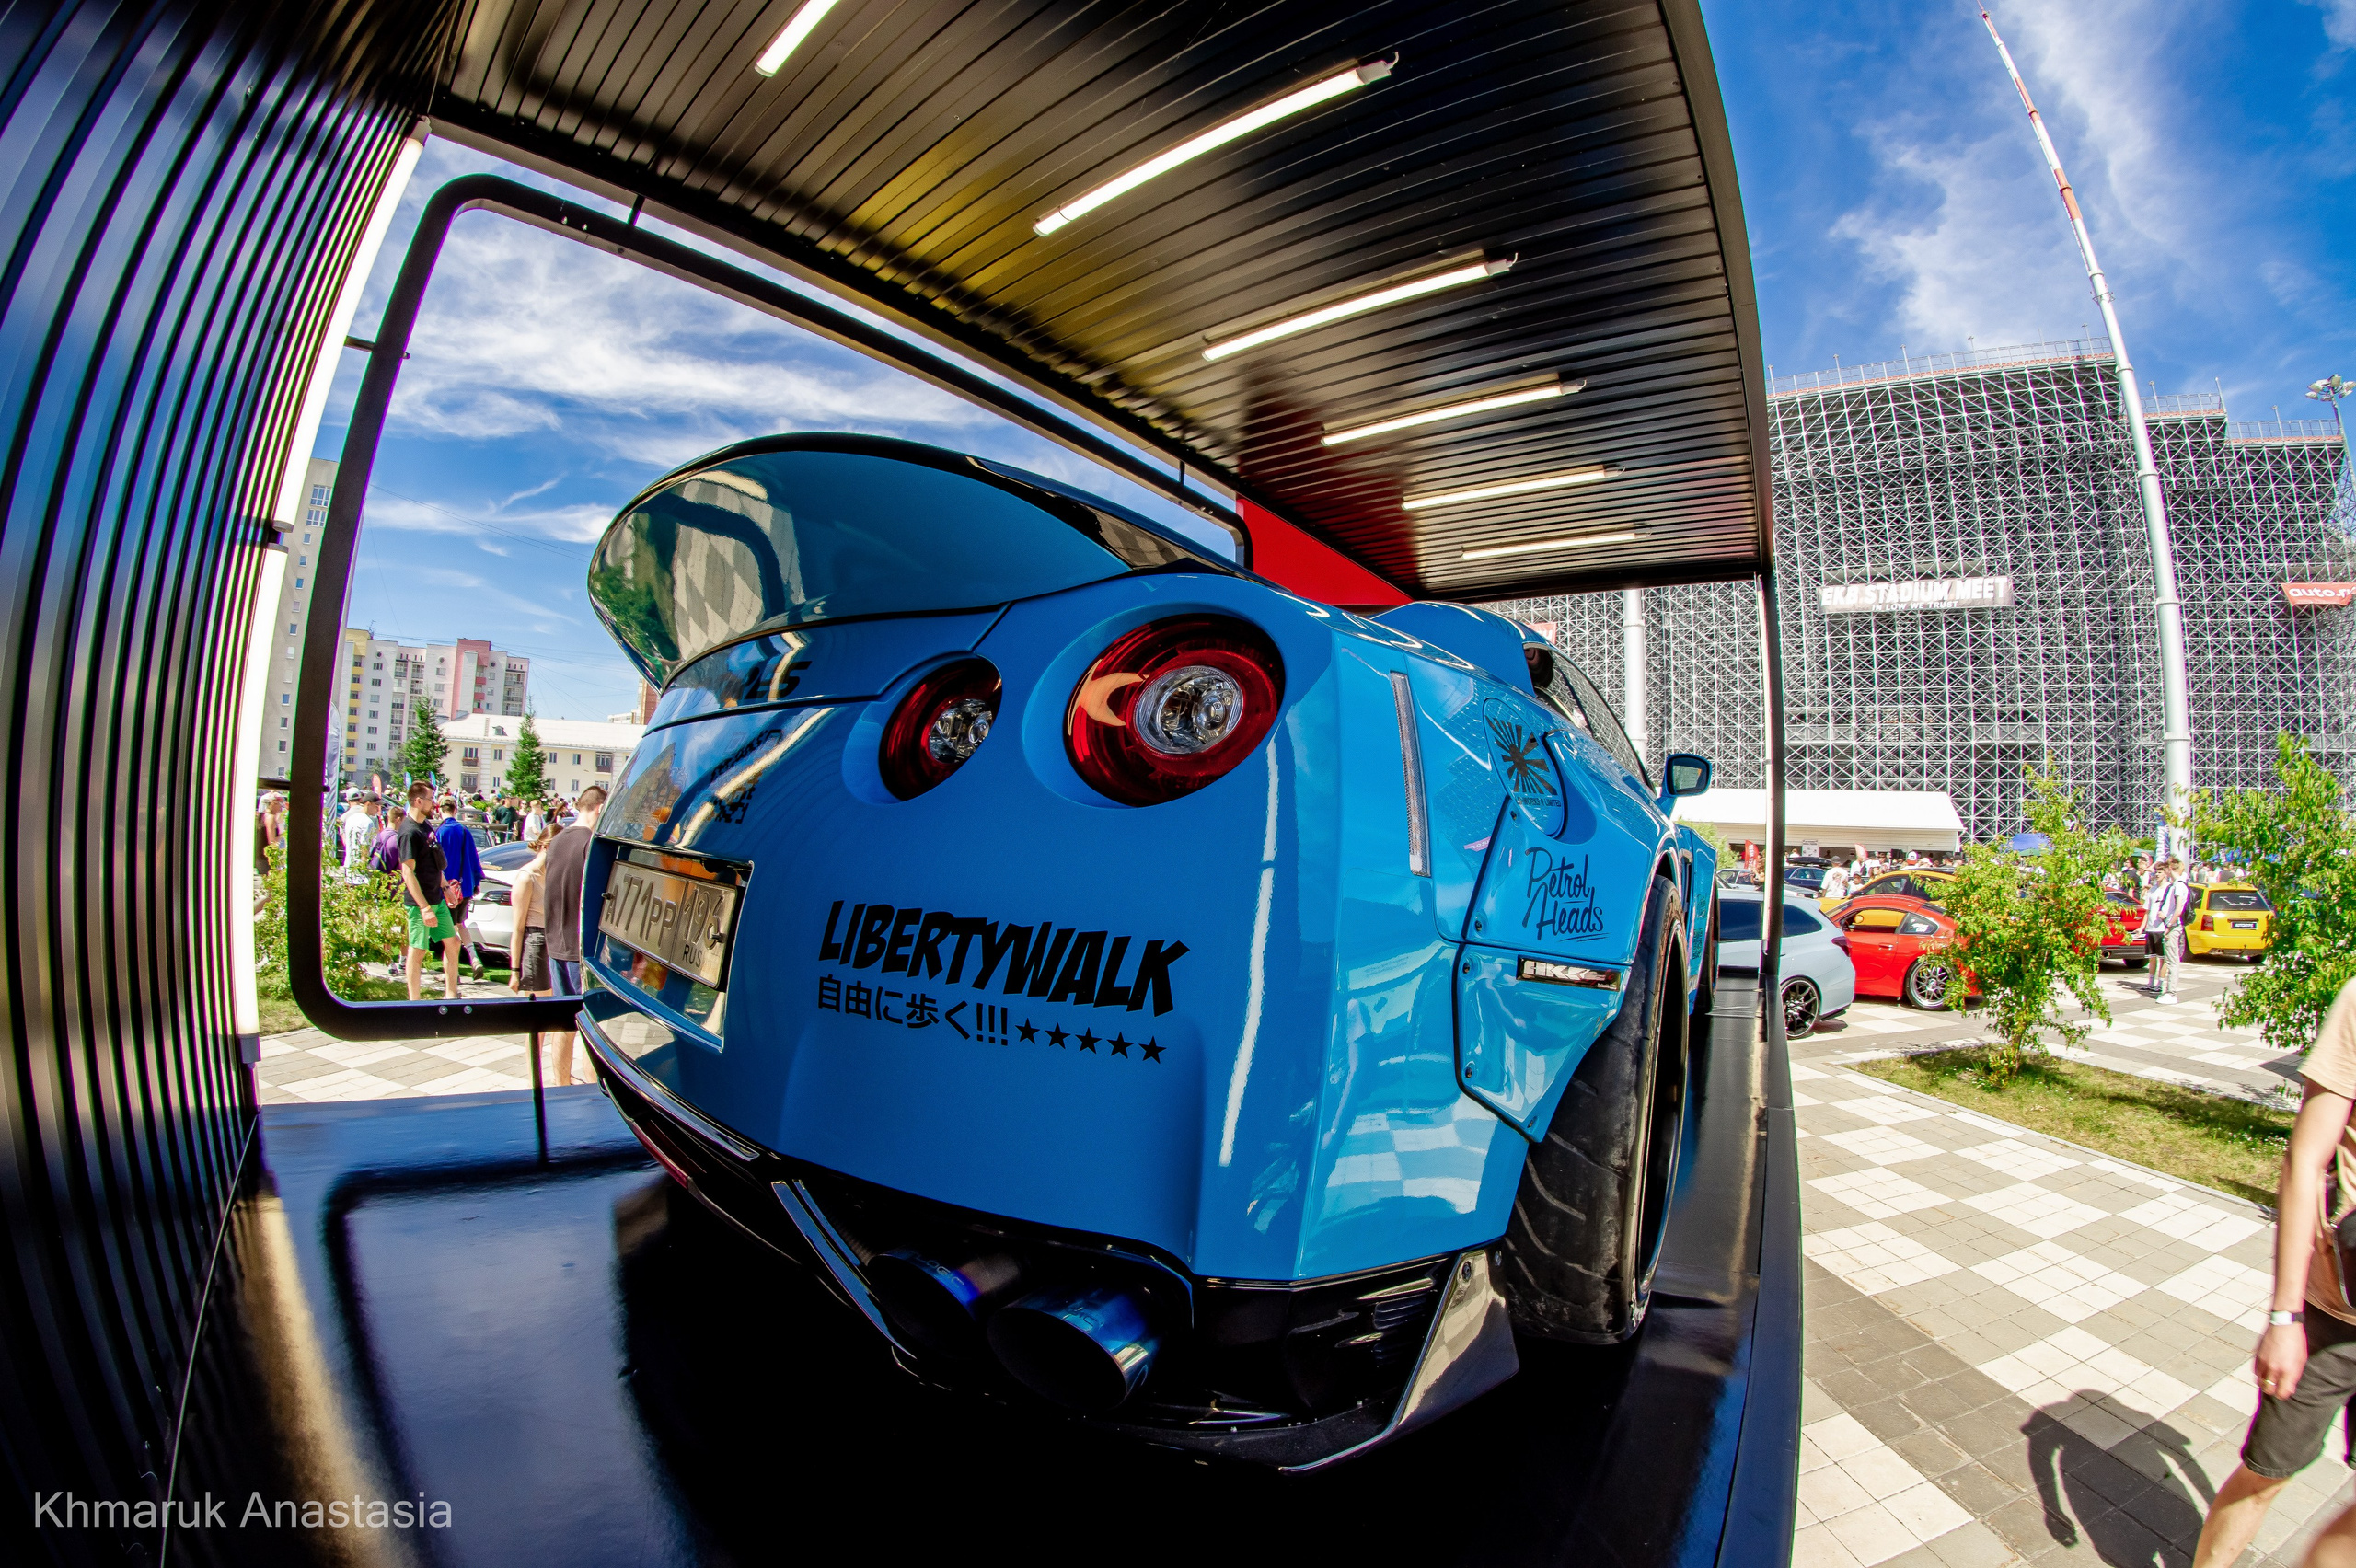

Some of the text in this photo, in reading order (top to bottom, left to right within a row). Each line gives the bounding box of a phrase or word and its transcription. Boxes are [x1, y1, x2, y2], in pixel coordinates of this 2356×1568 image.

[1820, 577, 2008, 606] EKB STADIUM MEET
[1525, 847, 1591, 898] Petrol
[1522, 883, 1603, 940] Heads
[682, 943, 703, 969] RUS
[818, 900, 1191, 1018] LIBERTYWALK
